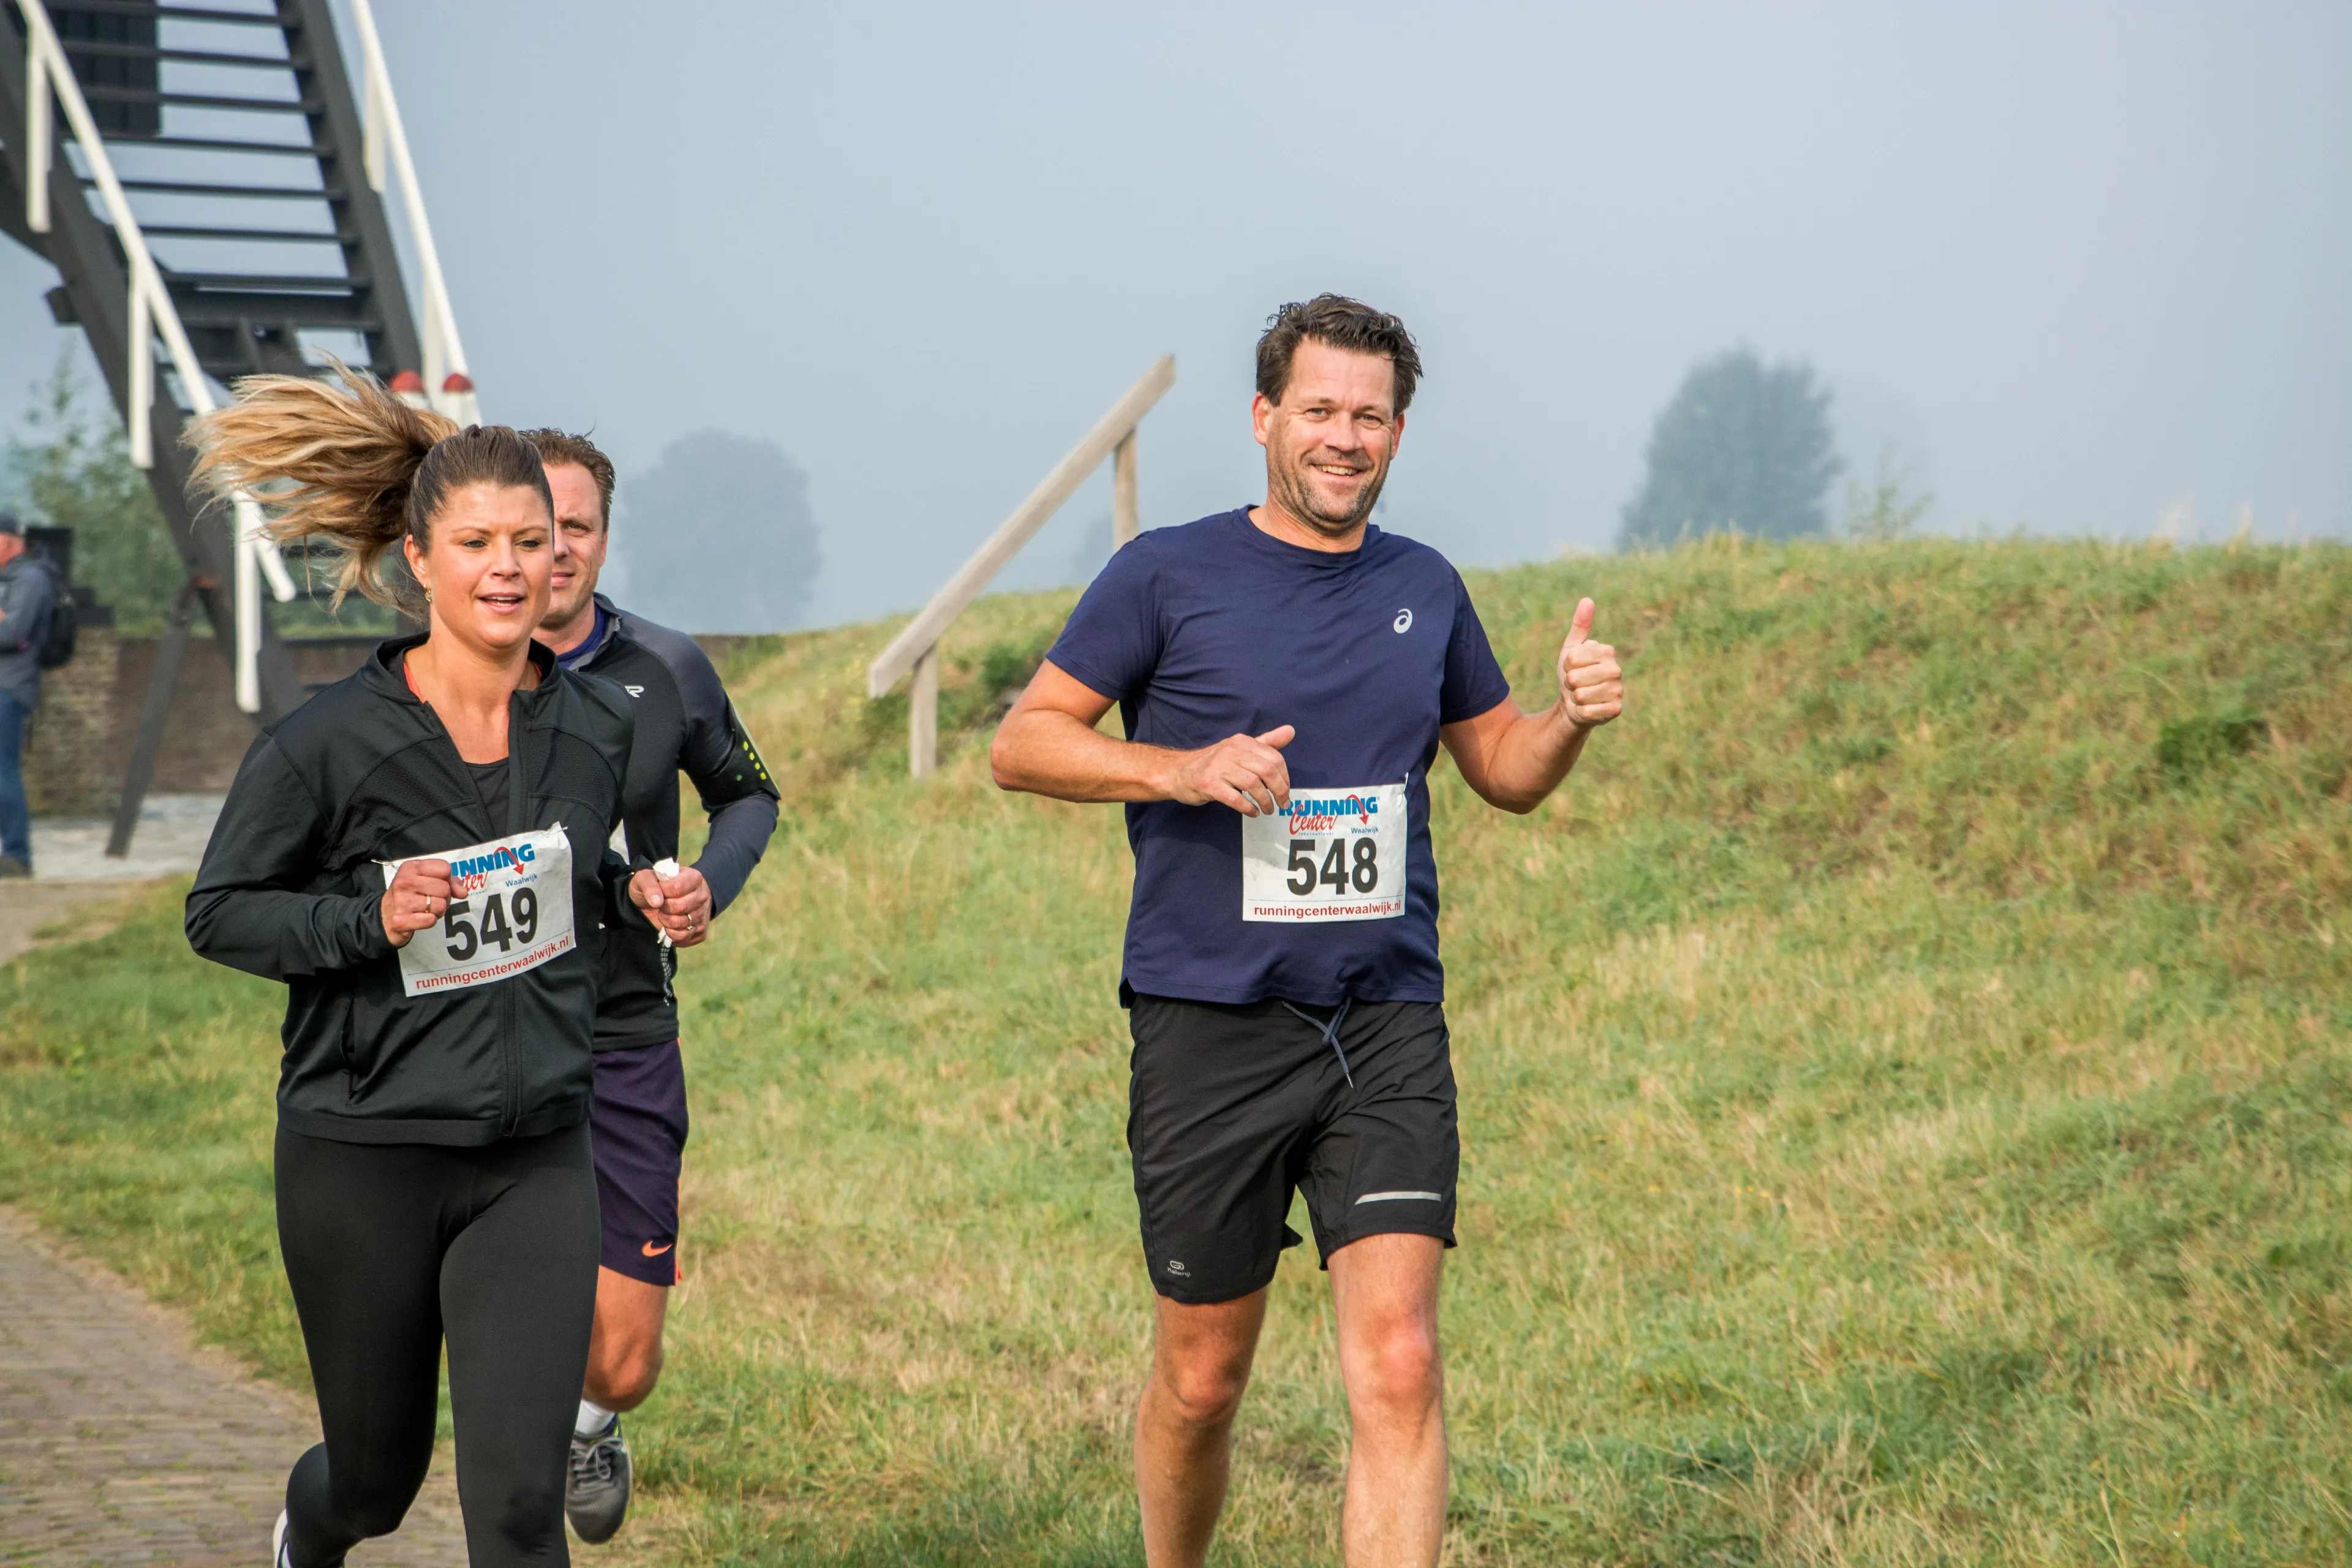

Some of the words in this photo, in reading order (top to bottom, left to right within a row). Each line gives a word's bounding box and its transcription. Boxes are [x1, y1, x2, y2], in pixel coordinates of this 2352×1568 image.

[1279, 797, 1378, 816] RUNNING
[1289, 804, 1338, 835] Center
[505, 873, 538, 888] Waalwijk
[1287, 837, 1378, 896] 548
[444, 887, 538, 961] 549
[1254, 900, 1401, 919] runningcenterwaalwijk.nl
[416, 936, 568, 989] runningcenterwaalwijk.nl
